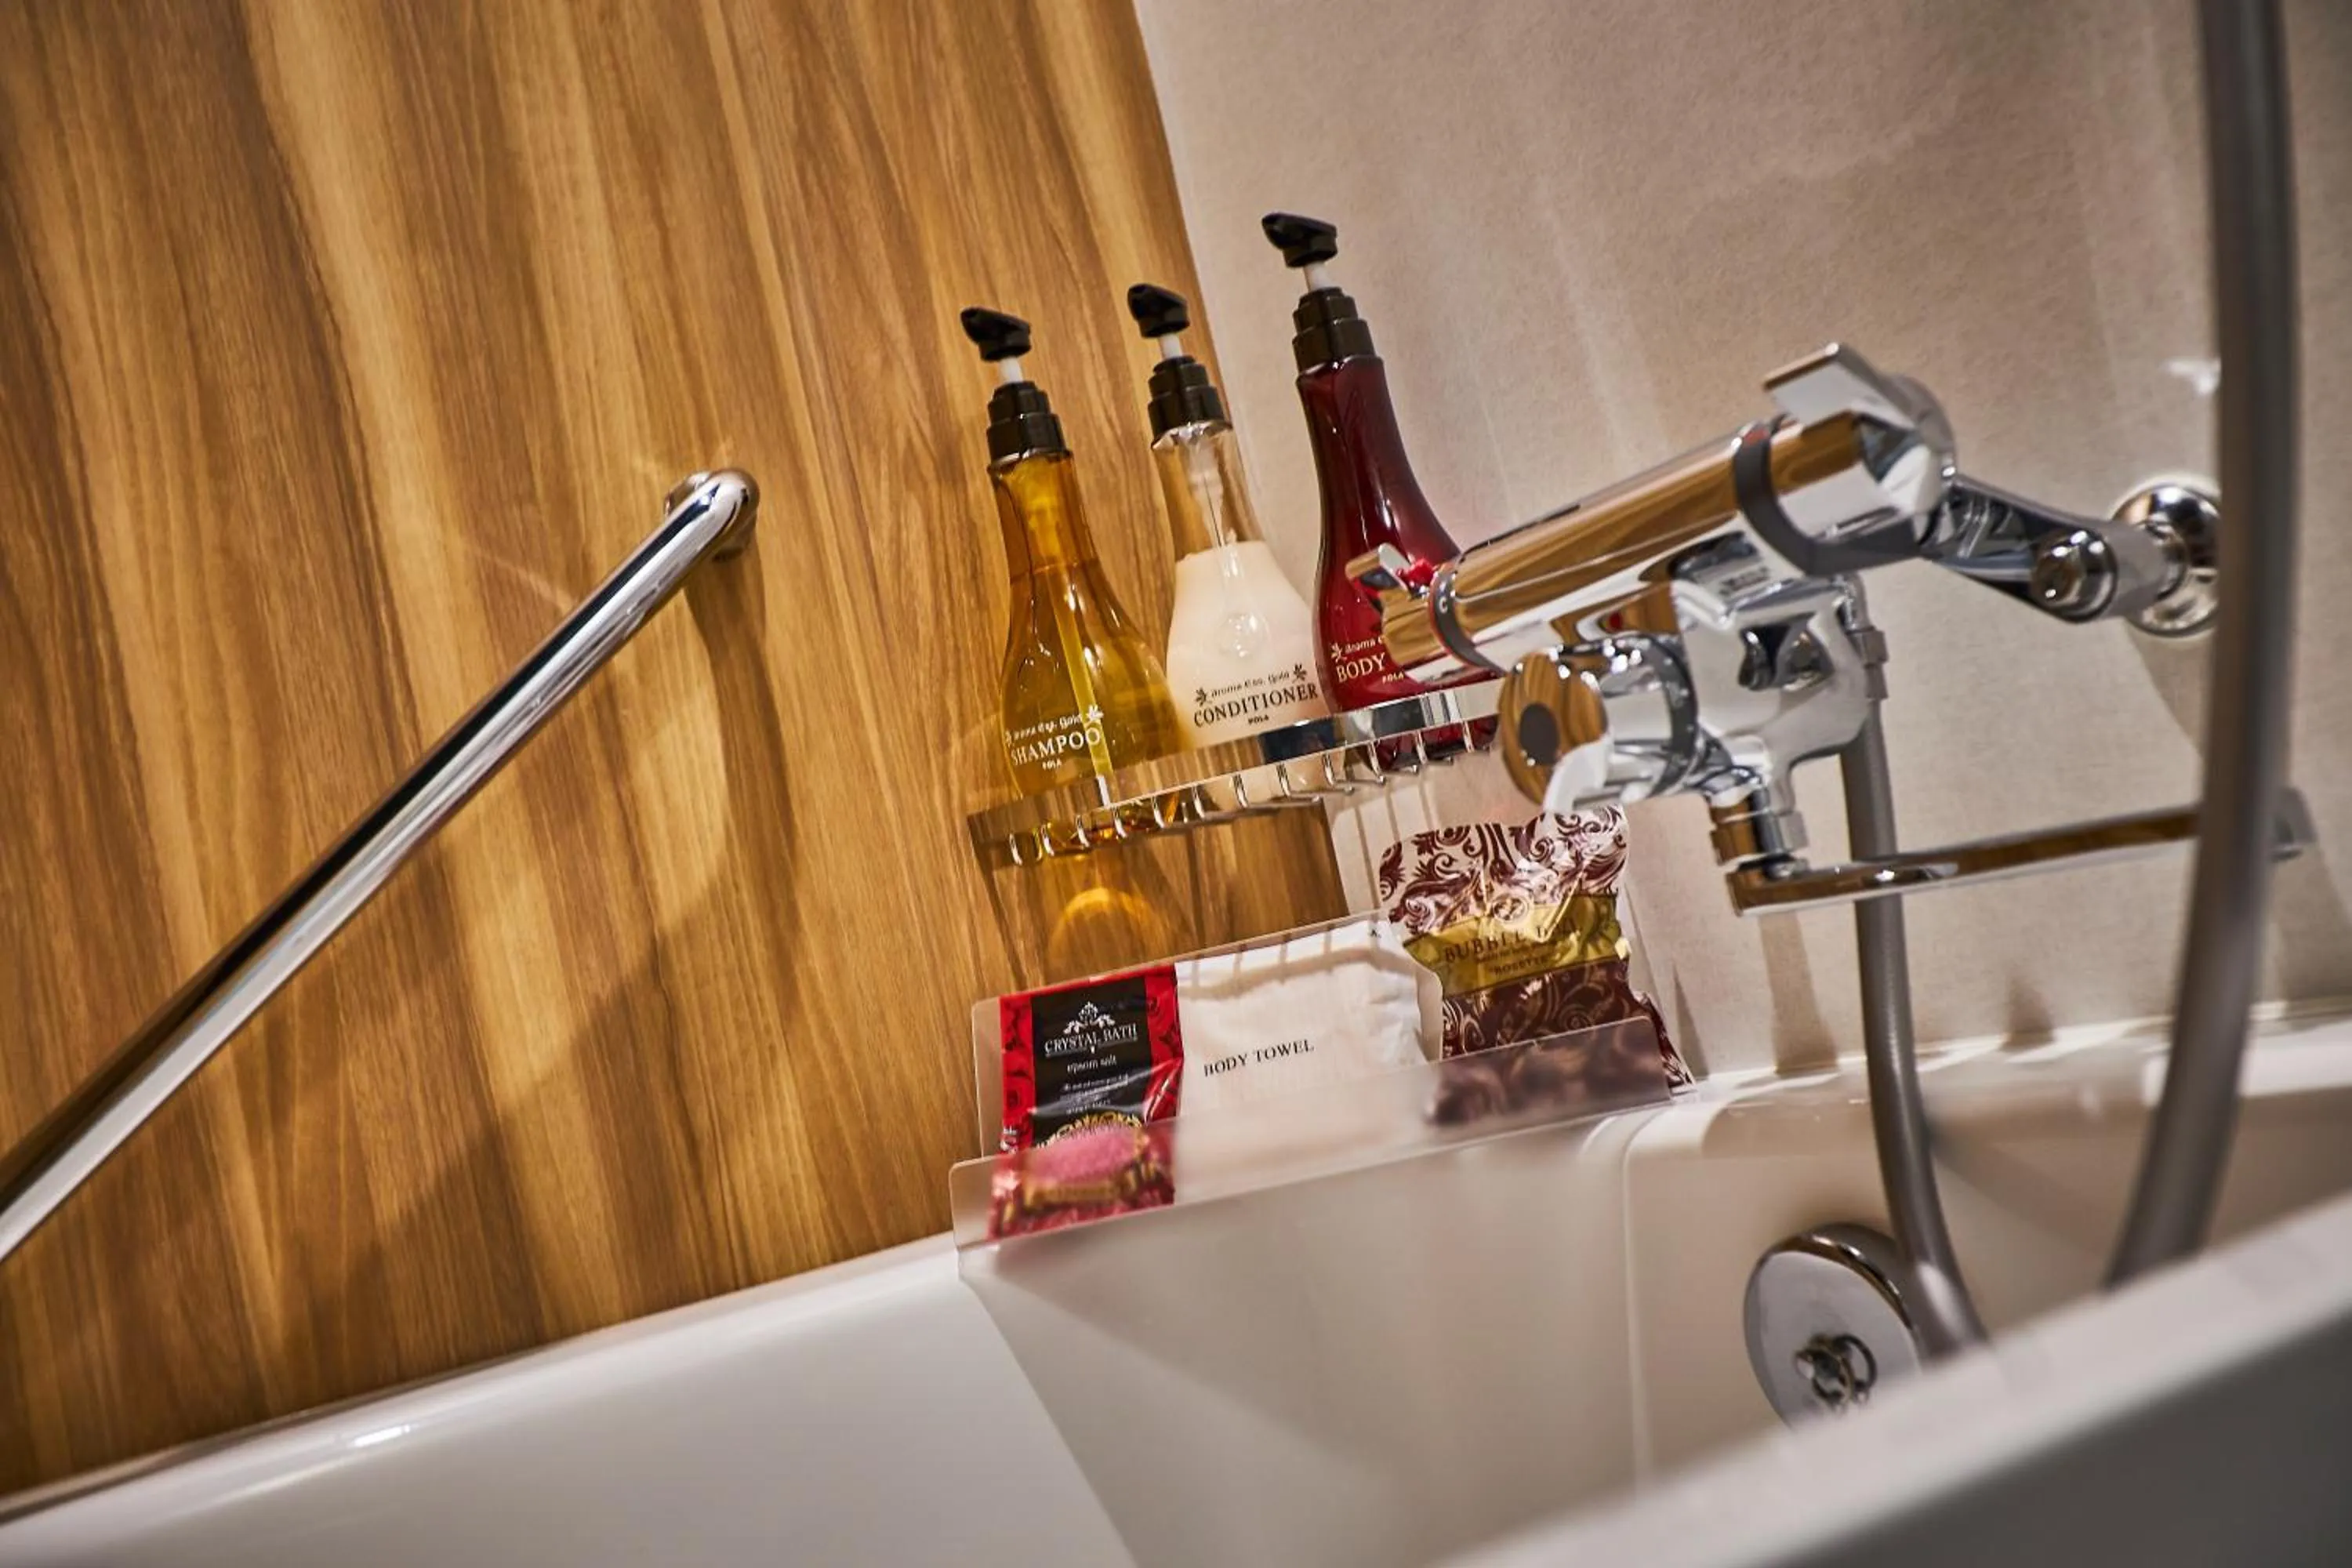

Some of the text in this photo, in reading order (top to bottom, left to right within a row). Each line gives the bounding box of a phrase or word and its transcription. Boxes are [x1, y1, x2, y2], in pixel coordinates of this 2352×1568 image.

[1336, 652, 1385, 683] BODY
[1194, 683, 1319, 728] CONDITIONER
[1011, 727, 1100, 766] SHAMPOO
[1044, 1022, 1136, 1054] CRYSTAL BATH
[1203, 1039, 1315, 1077] BODY TOWEL
